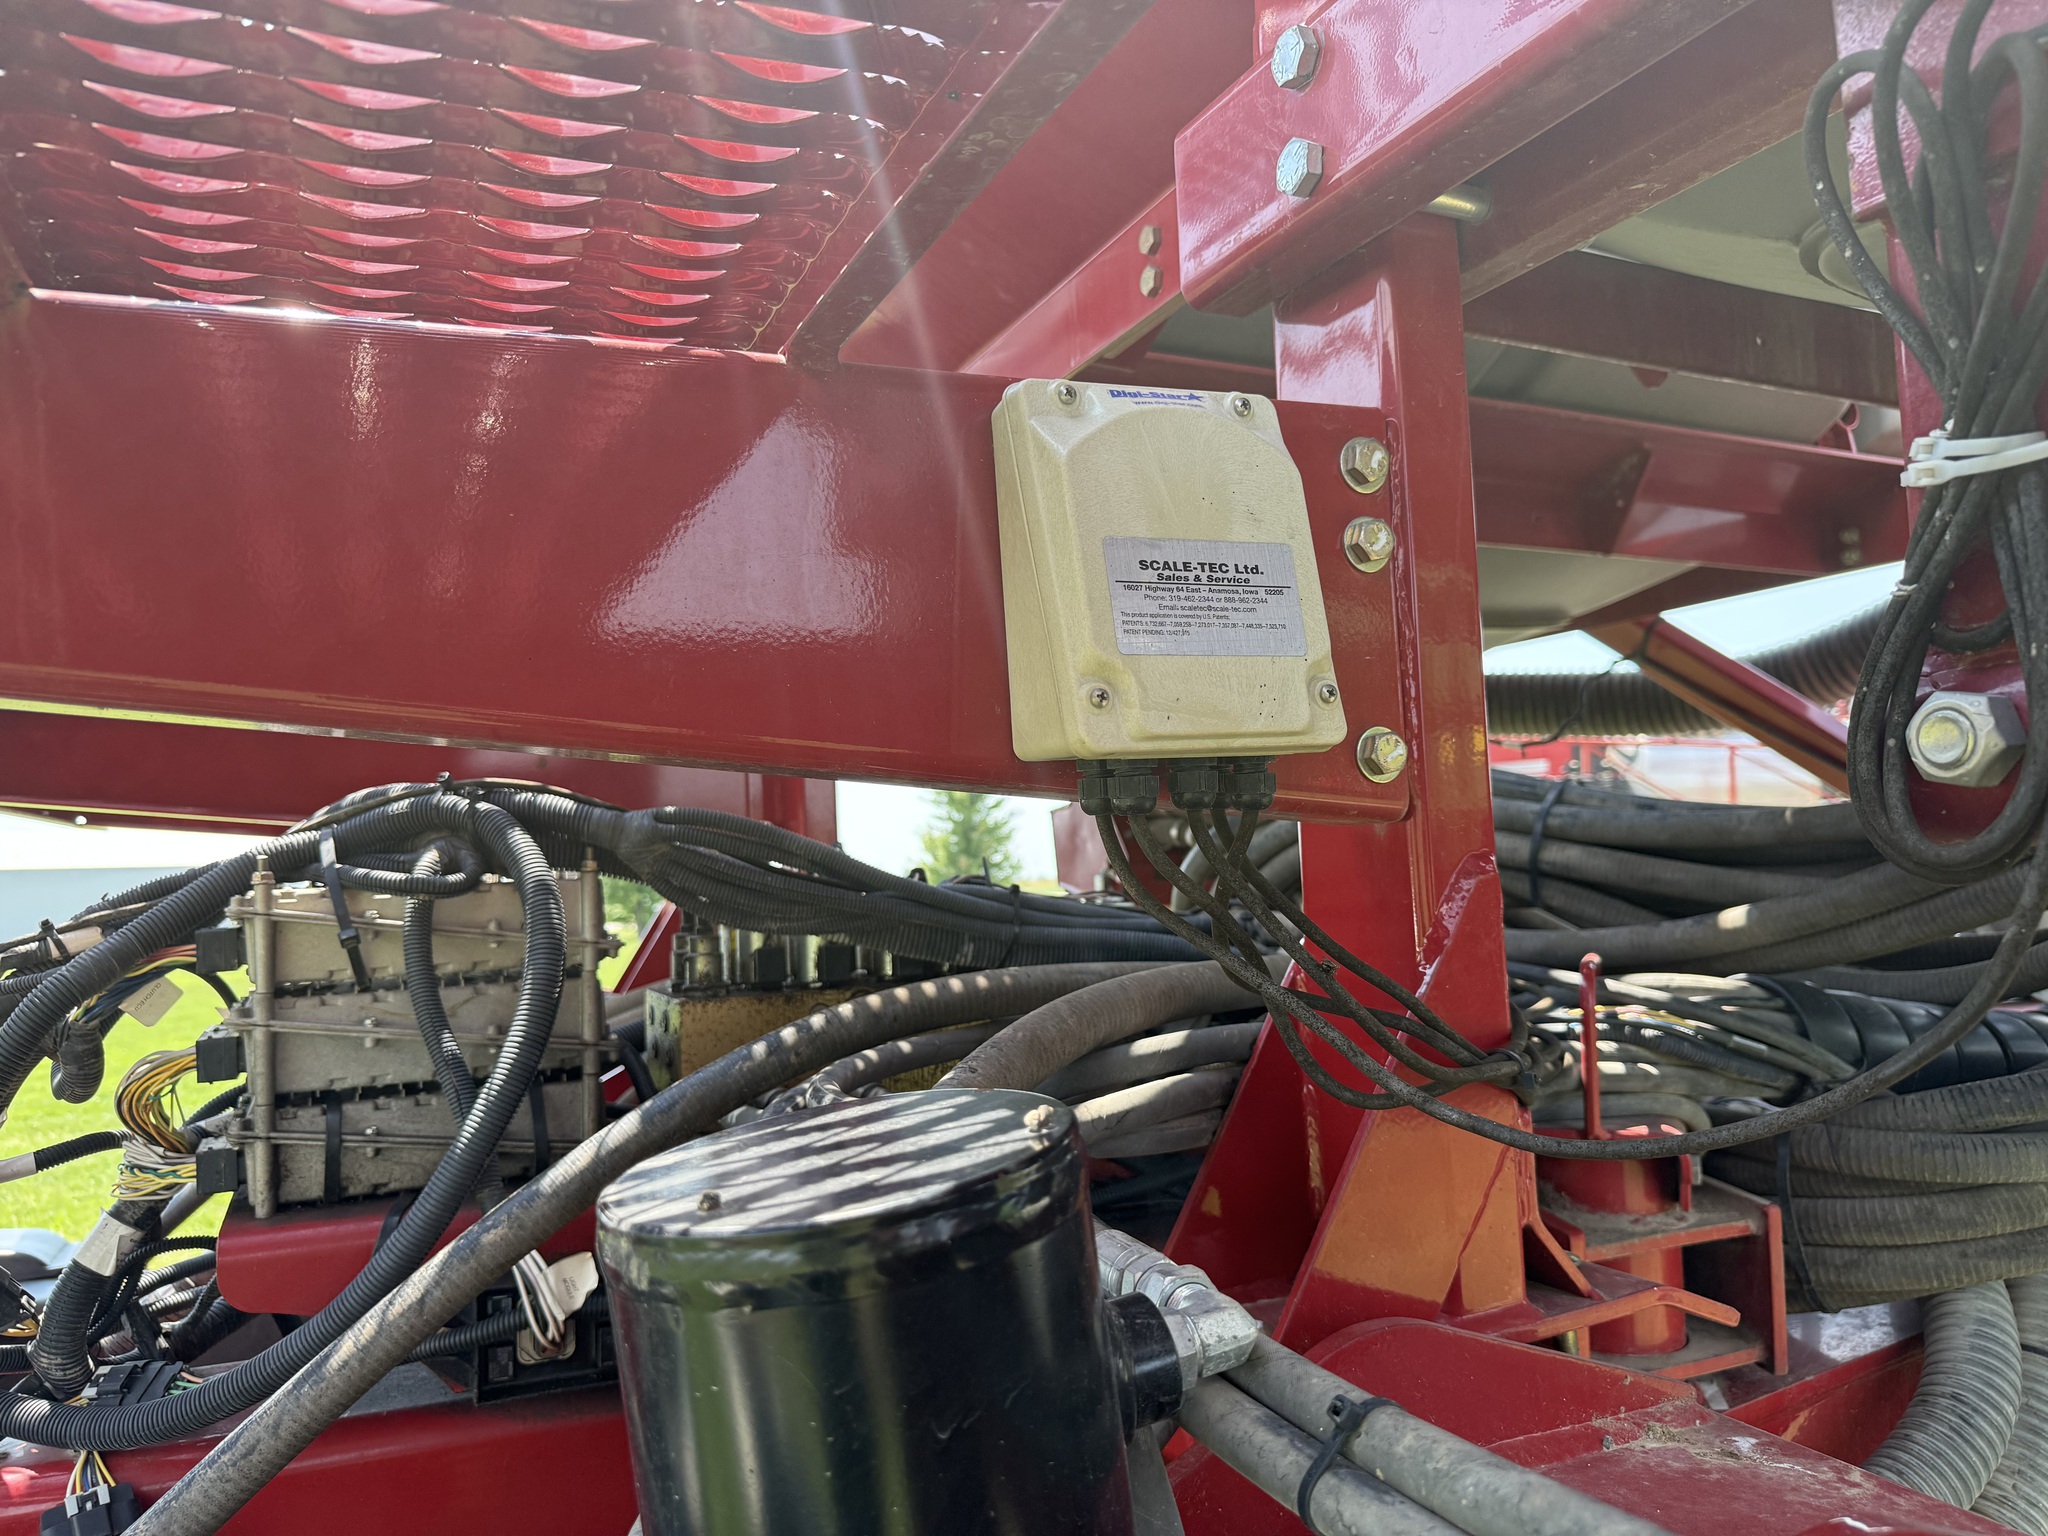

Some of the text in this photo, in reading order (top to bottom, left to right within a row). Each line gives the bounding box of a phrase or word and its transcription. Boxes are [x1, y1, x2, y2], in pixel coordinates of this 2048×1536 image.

[1108, 389, 1188, 401] Digi-Star
[1138, 559, 1264, 575] SCALE-TEC Ltd.
[1157, 572, 1250, 584] Sales & Service
[1122, 583, 1143, 591] 16027
[1145, 584, 1174, 594] Highway
[1207, 587, 1241, 595] Anamosa,
[1264, 588, 1285, 596] 52205
[1143, 593, 1168, 602] Phone:
[1168, 595, 1214, 603] 319-462-2344
[1223, 596, 1268, 604] 888-962-2344
[1158, 603, 1257, 613] Email: scaletec@scale-tec.com
[134, 982, 162, 1011] CLUTCH ECU
